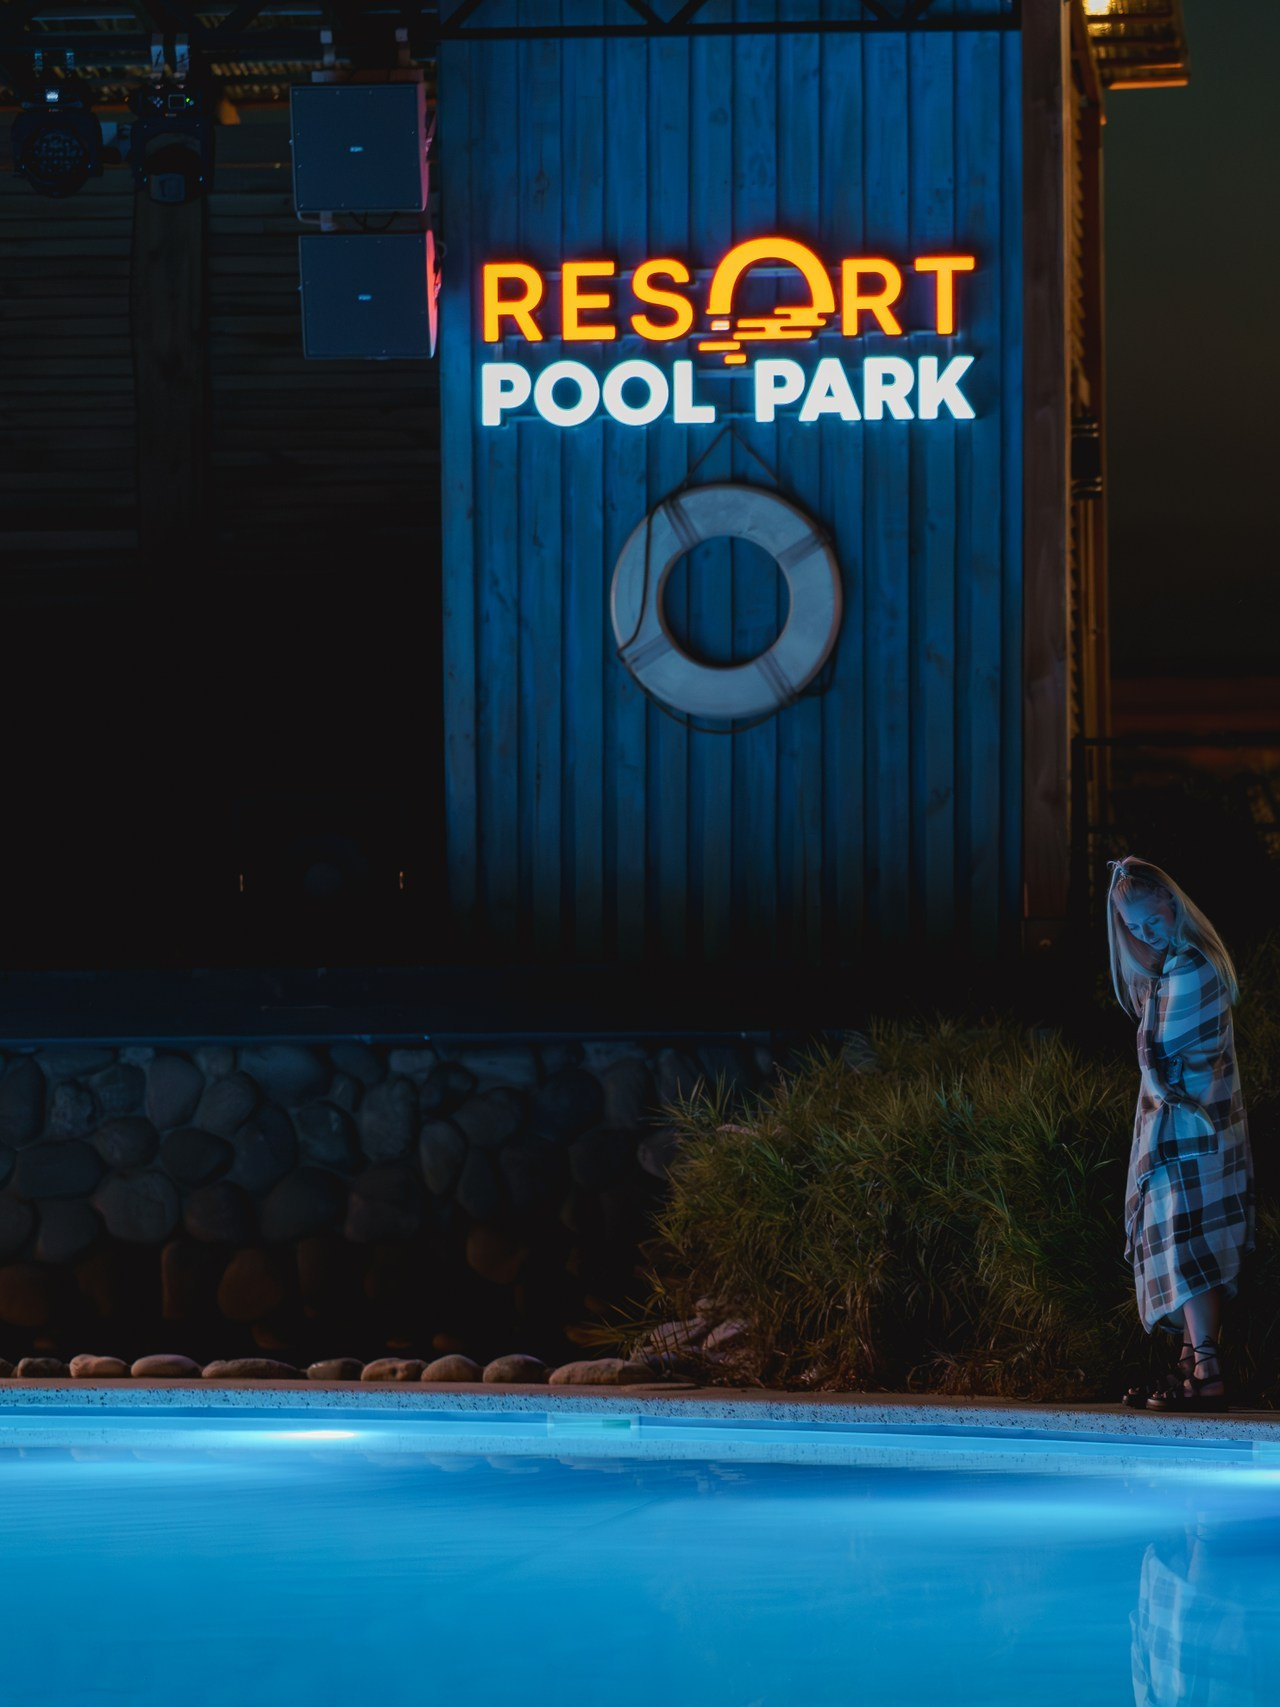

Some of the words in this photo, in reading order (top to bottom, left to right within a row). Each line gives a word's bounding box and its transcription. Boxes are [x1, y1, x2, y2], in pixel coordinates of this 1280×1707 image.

[482, 236, 976, 346] RESORT
[481, 360, 716, 427] POOL
[754, 356, 976, 423] PARK
